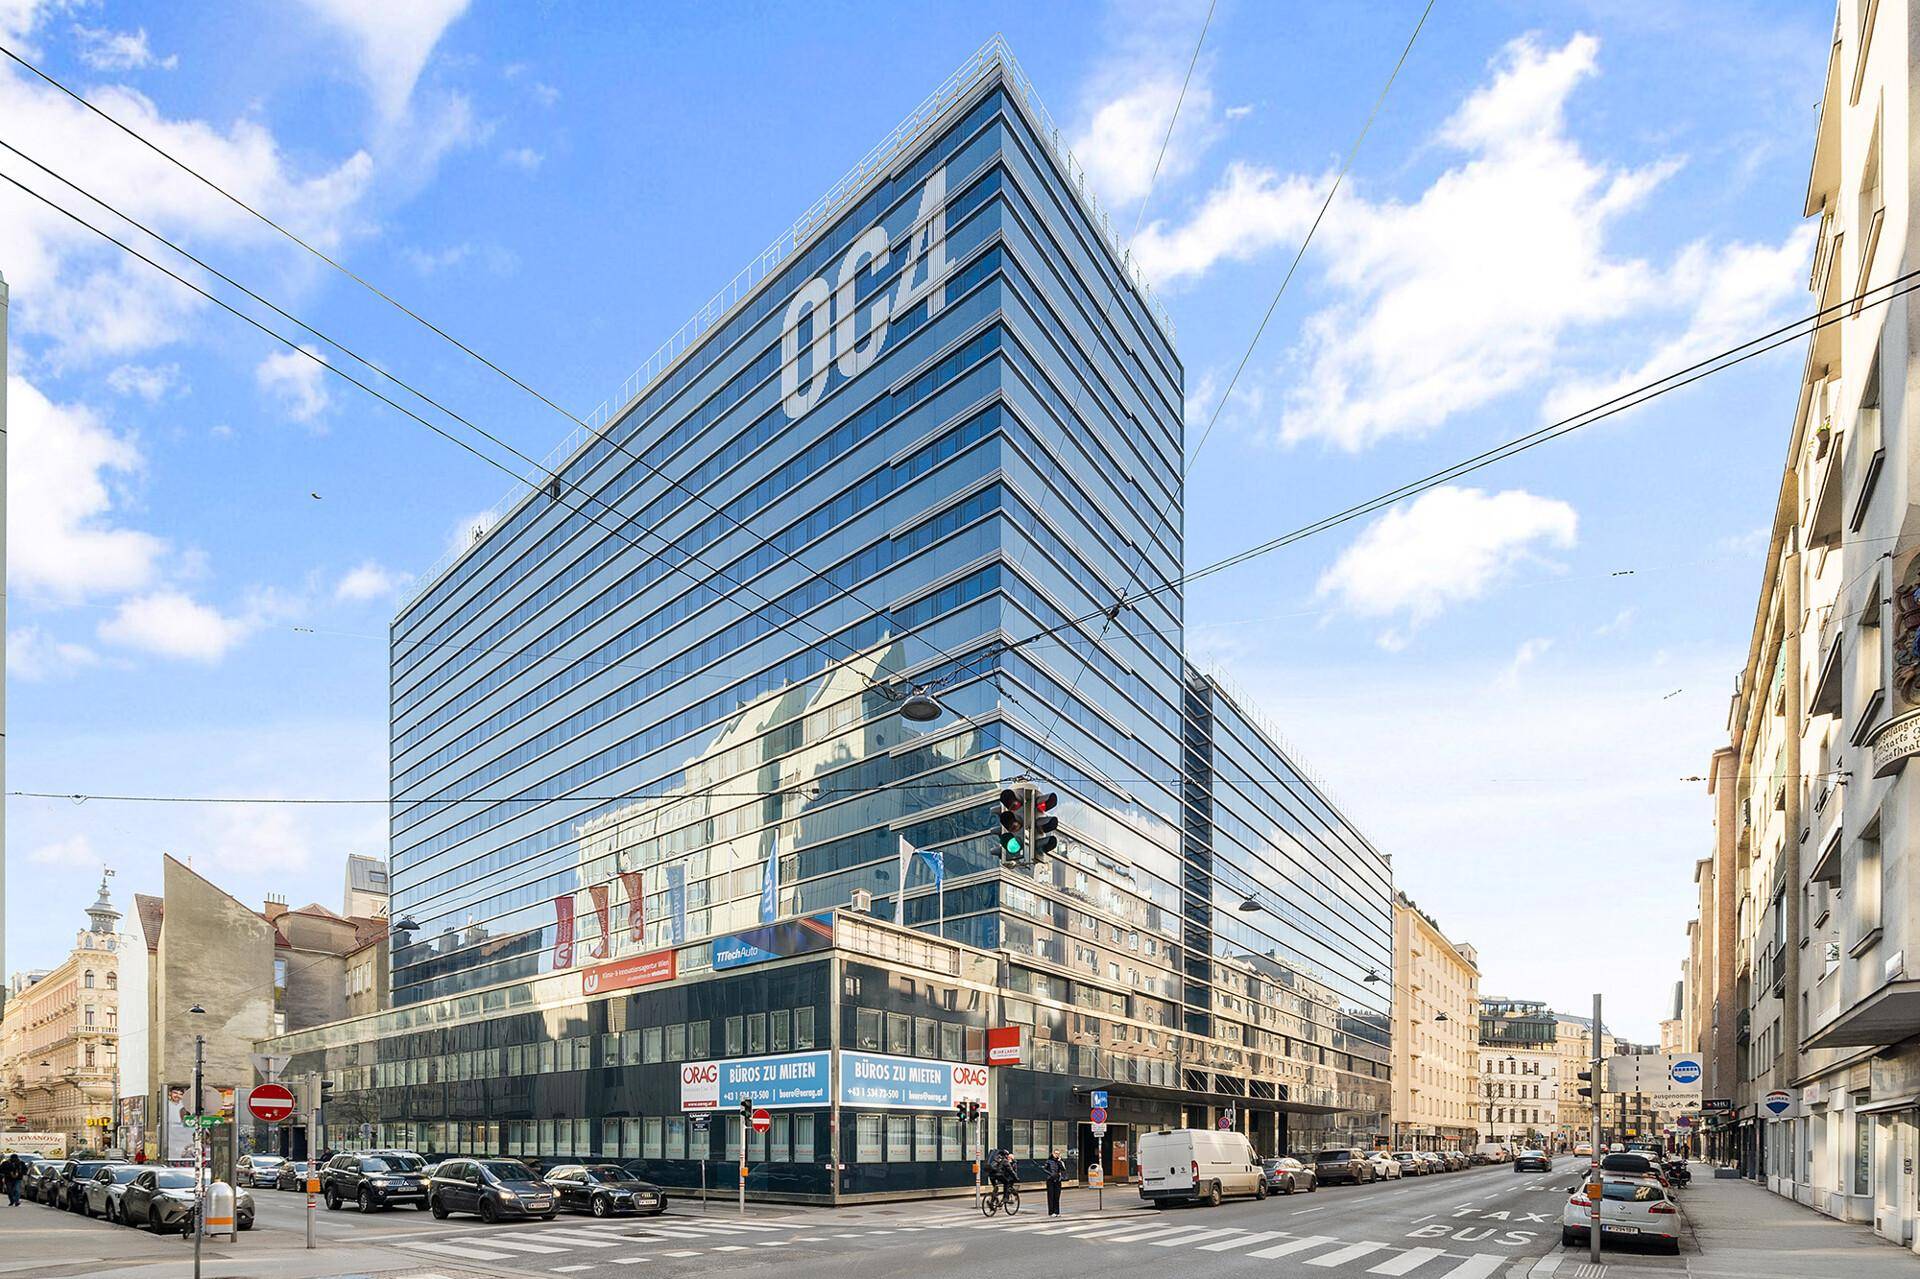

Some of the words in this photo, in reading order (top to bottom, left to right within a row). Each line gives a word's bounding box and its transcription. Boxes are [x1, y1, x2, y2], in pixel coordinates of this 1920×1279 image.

[729, 1063, 761, 1084] BÜROS
[763, 1065, 777, 1081] ZU
[779, 1062, 816, 1080] MIETEN
[854, 1059, 890, 1081] BÜROS
[892, 1067, 906, 1082] ZU
[908, 1067, 942, 1084] MIETEN
[1405, 1224, 1539, 1246] BUS
